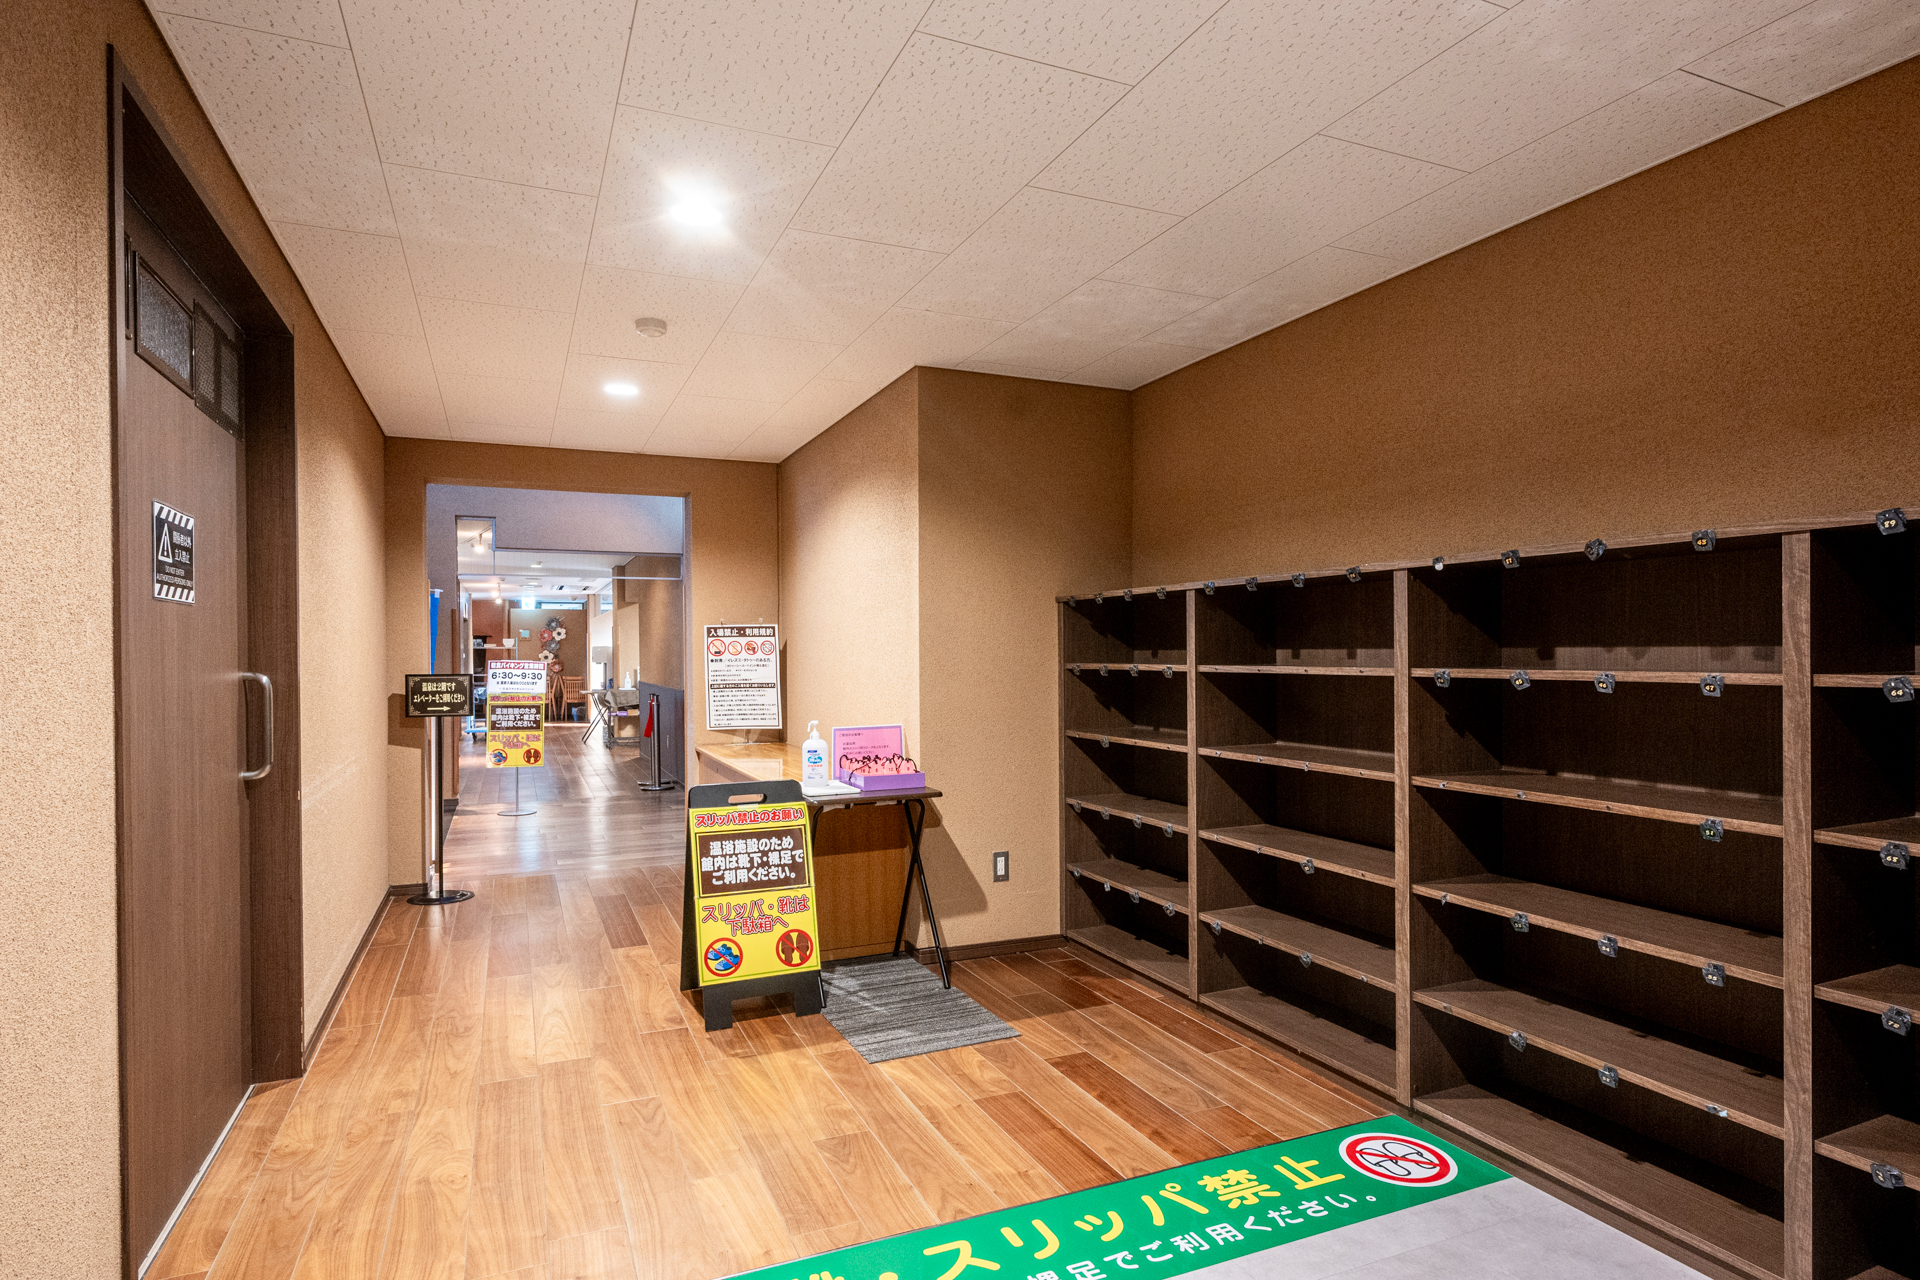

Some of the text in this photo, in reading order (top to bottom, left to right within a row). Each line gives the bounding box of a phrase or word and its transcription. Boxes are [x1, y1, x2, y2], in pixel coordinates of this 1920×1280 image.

[173, 531, 192, 548] 関係者以外
[175, 549, 190, 563] 立入禁止
[709, 628, 774, 637] 入場禁止・利用規約
[413, 693, 466, 703] エレベーターをご利用ください
[1890, 689, 1903, 697] 64
[495, 707, 537, 715] 温浴施設のため
[695, 807, 804, 828] スリッパ禁止のお願い
[709, 835, 794, 856] 温浴施設のため
[701, 849, 805, 872] 館内は靴下・裸足で
[712, 867, 797, 886] ご利用ください。
[701, 895, 810, 924] スリッパ・靴は
[725, 915, 789, 936] 下駄箱へ
[792, 1156, 1346, 1280] ・スリッパ禁止
